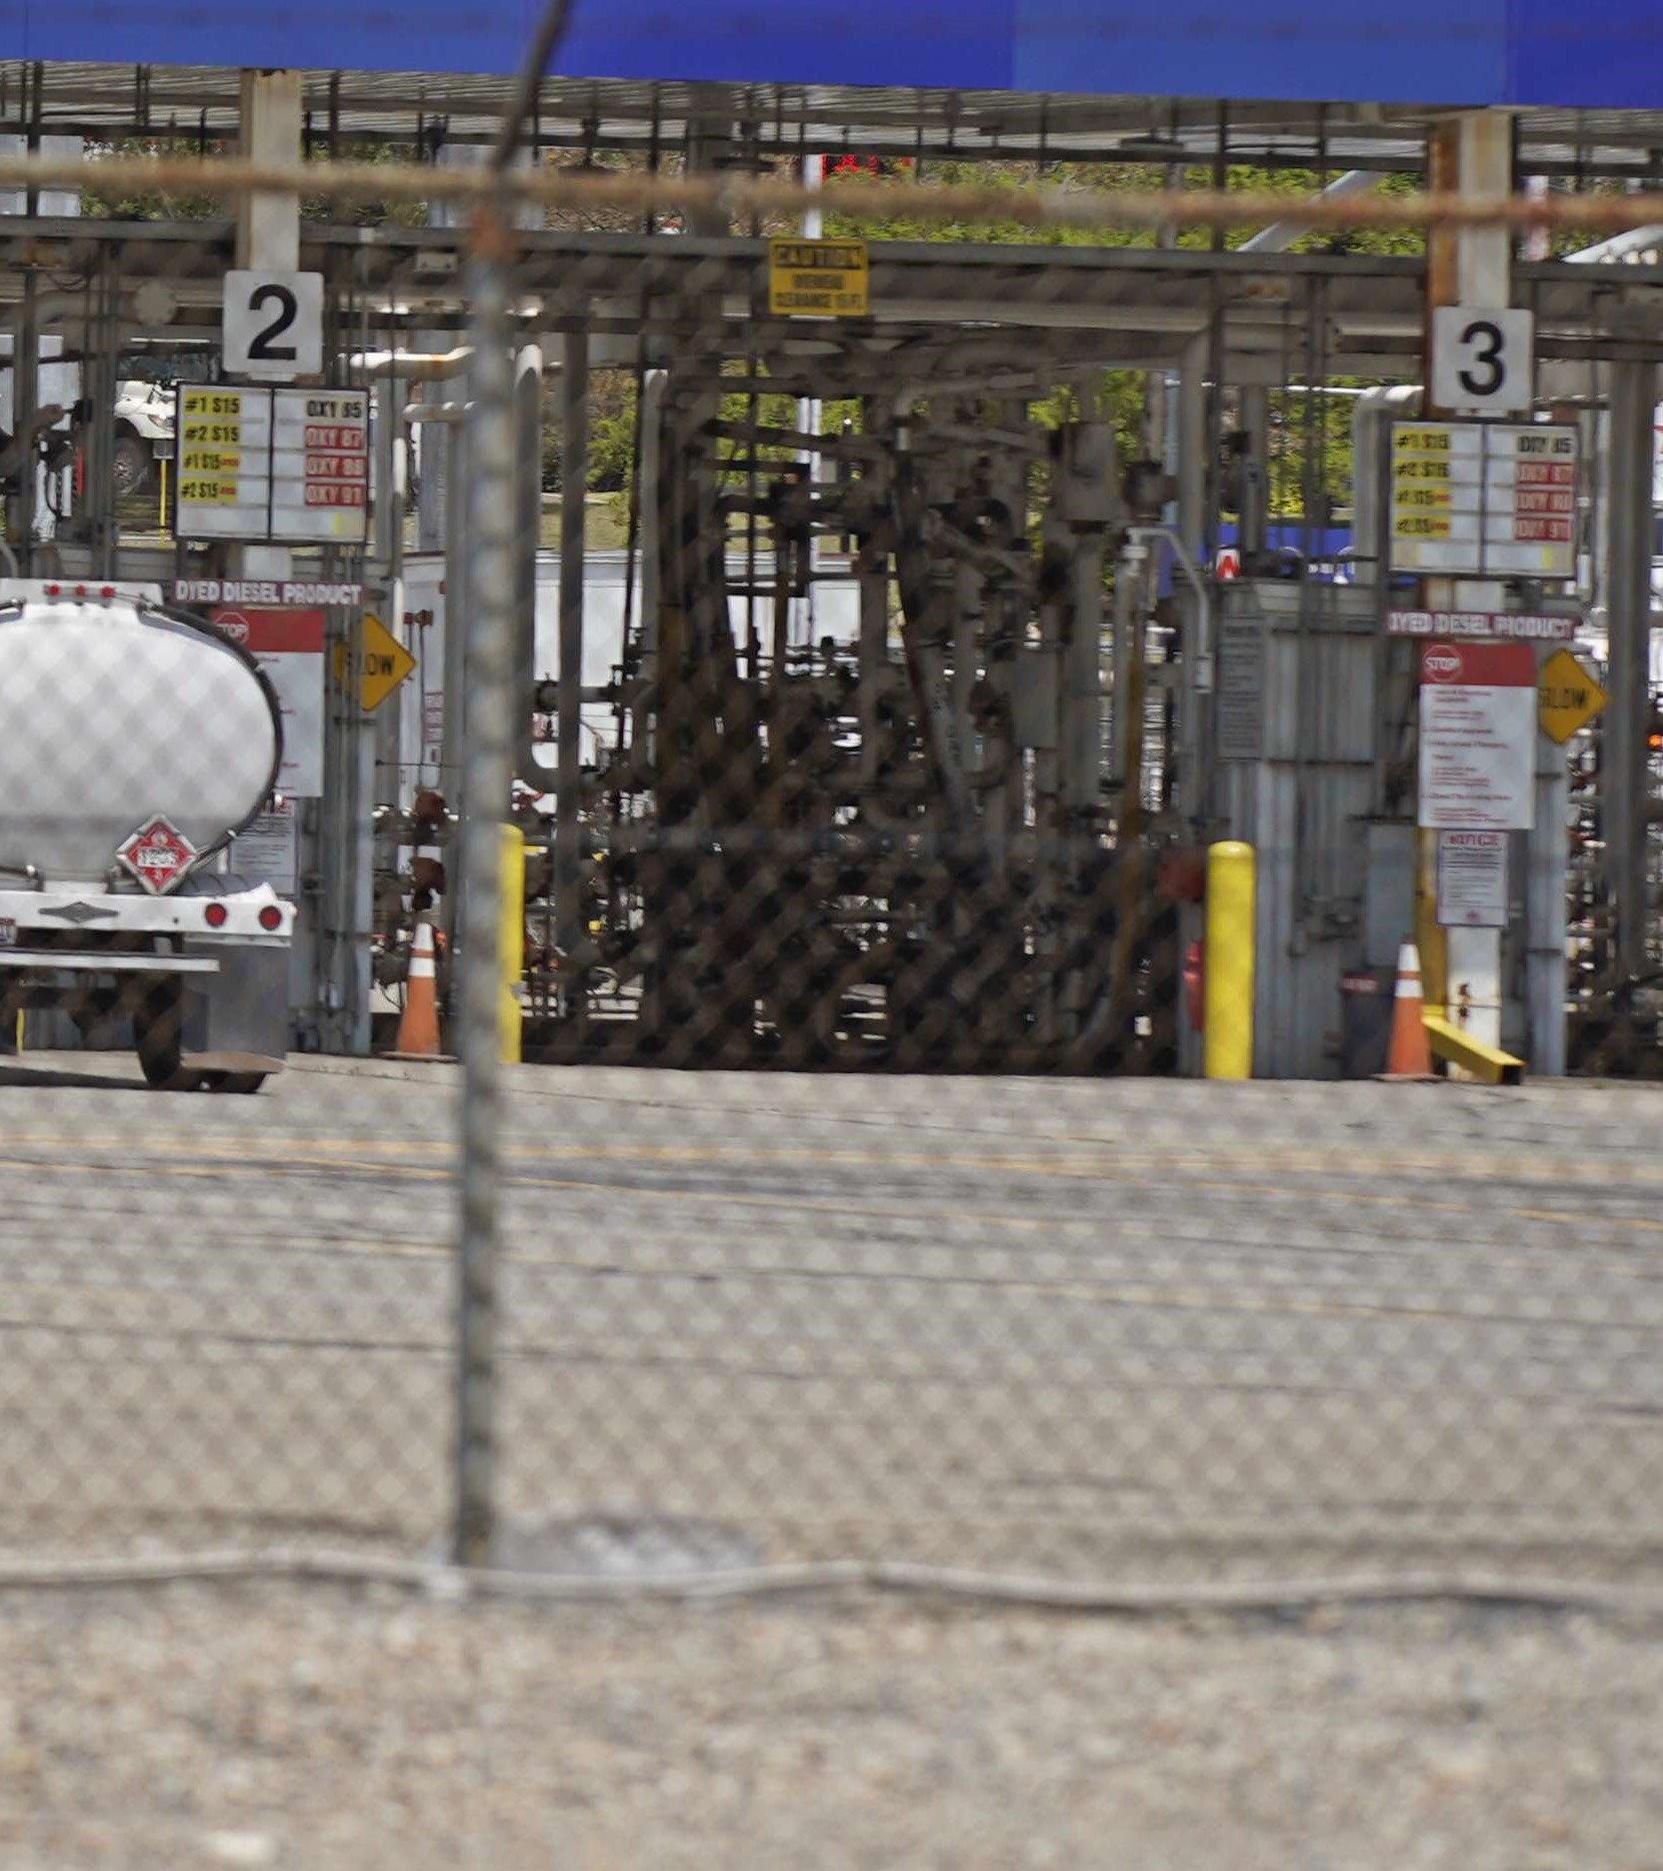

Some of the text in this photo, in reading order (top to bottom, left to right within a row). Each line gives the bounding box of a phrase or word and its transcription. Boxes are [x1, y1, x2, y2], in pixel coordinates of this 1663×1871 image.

[247, 283, 298, 360] 2
[1458, 321, 1505, 396] 3
[185, 397, 207, 413] #1
[185, 426, 206, 441] #2
[176, 580, 362, 606] DYED DIESEL PRODUCT
[220, 623, 247, 637] TOP
